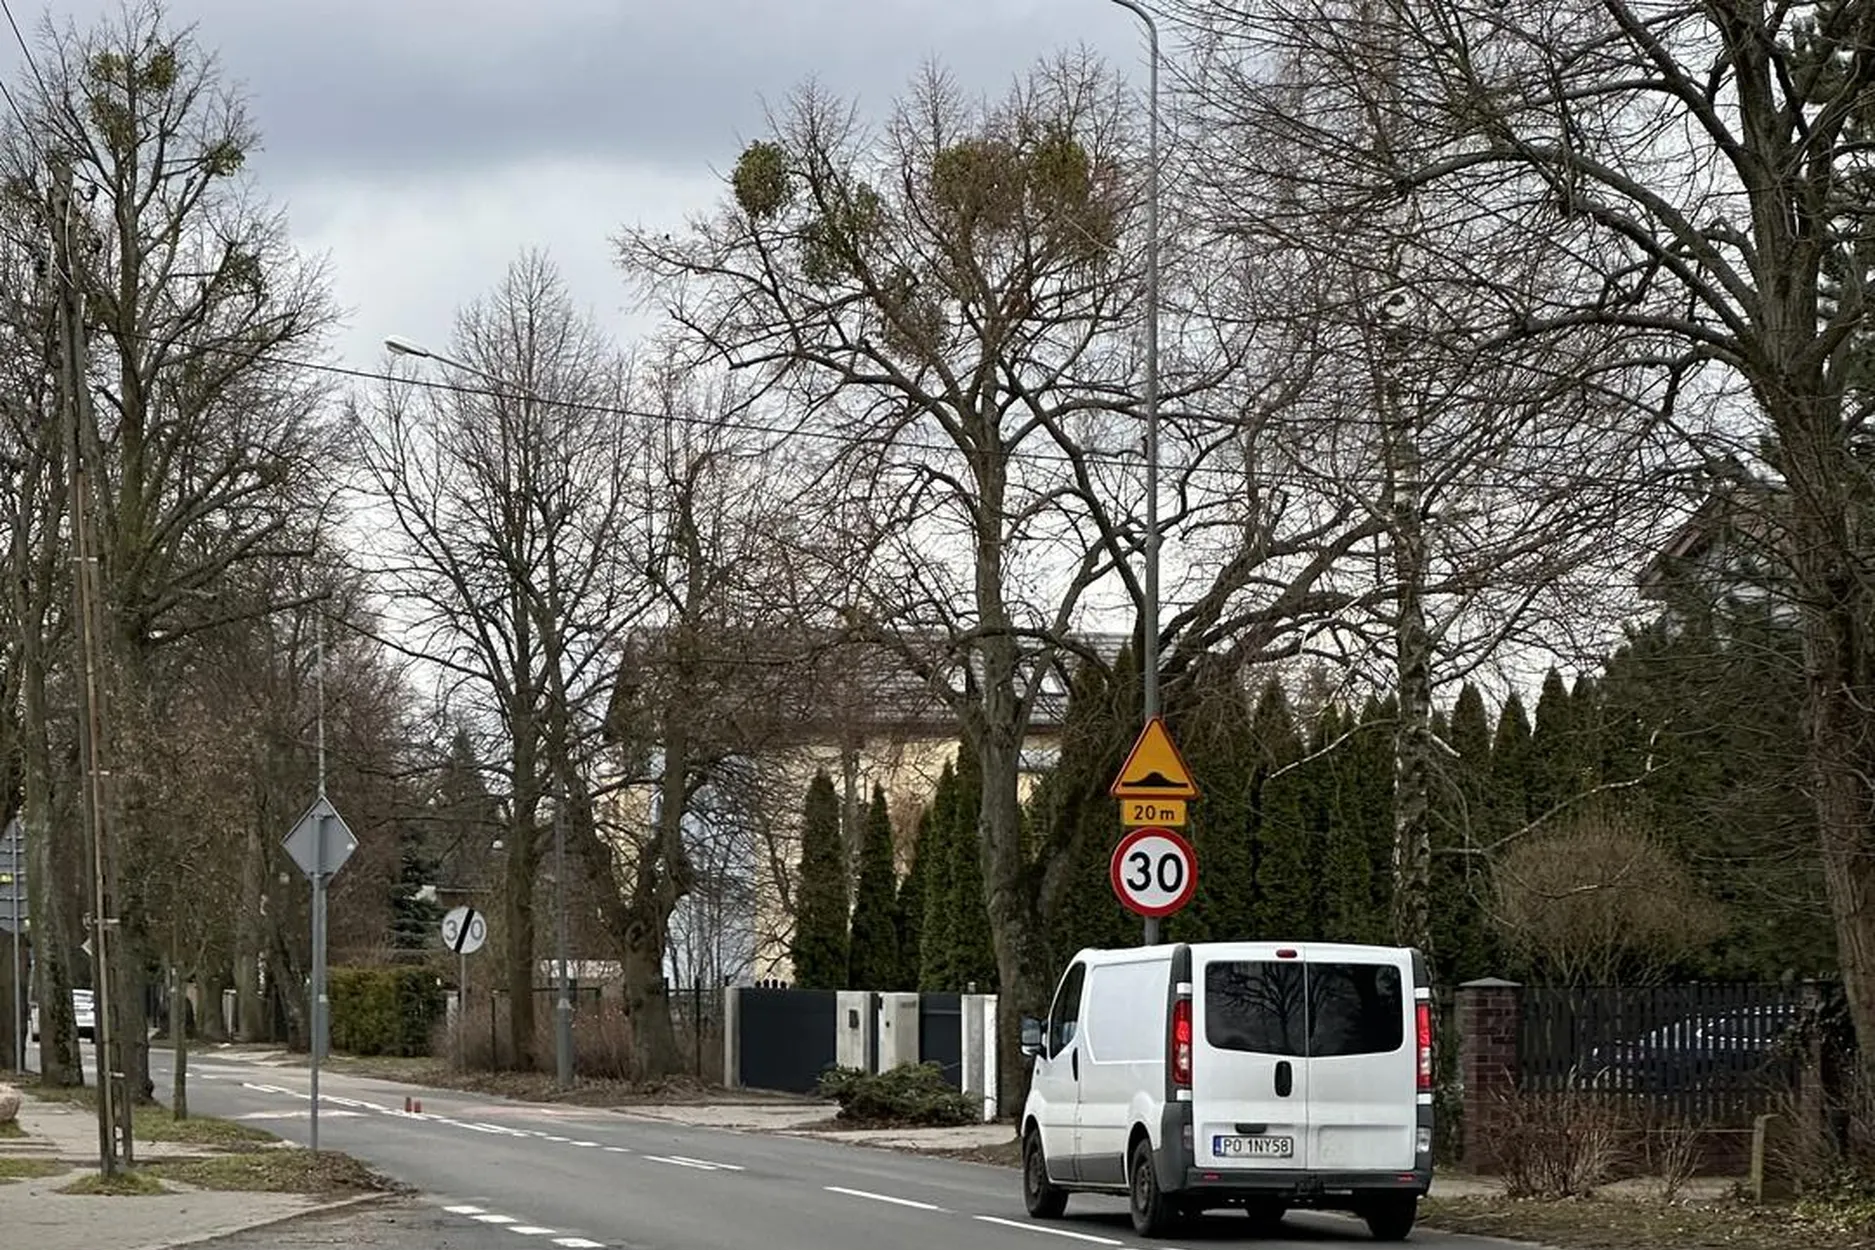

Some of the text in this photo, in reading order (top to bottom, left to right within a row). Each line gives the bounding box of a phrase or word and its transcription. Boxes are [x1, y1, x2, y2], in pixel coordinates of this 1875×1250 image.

[1134, 805, 1175, 820] 20 m
[1126, 851, 1183, 893] 30
[445, 920, 484, 942] 30
[1223, 1138, 1242, 1153] PO
